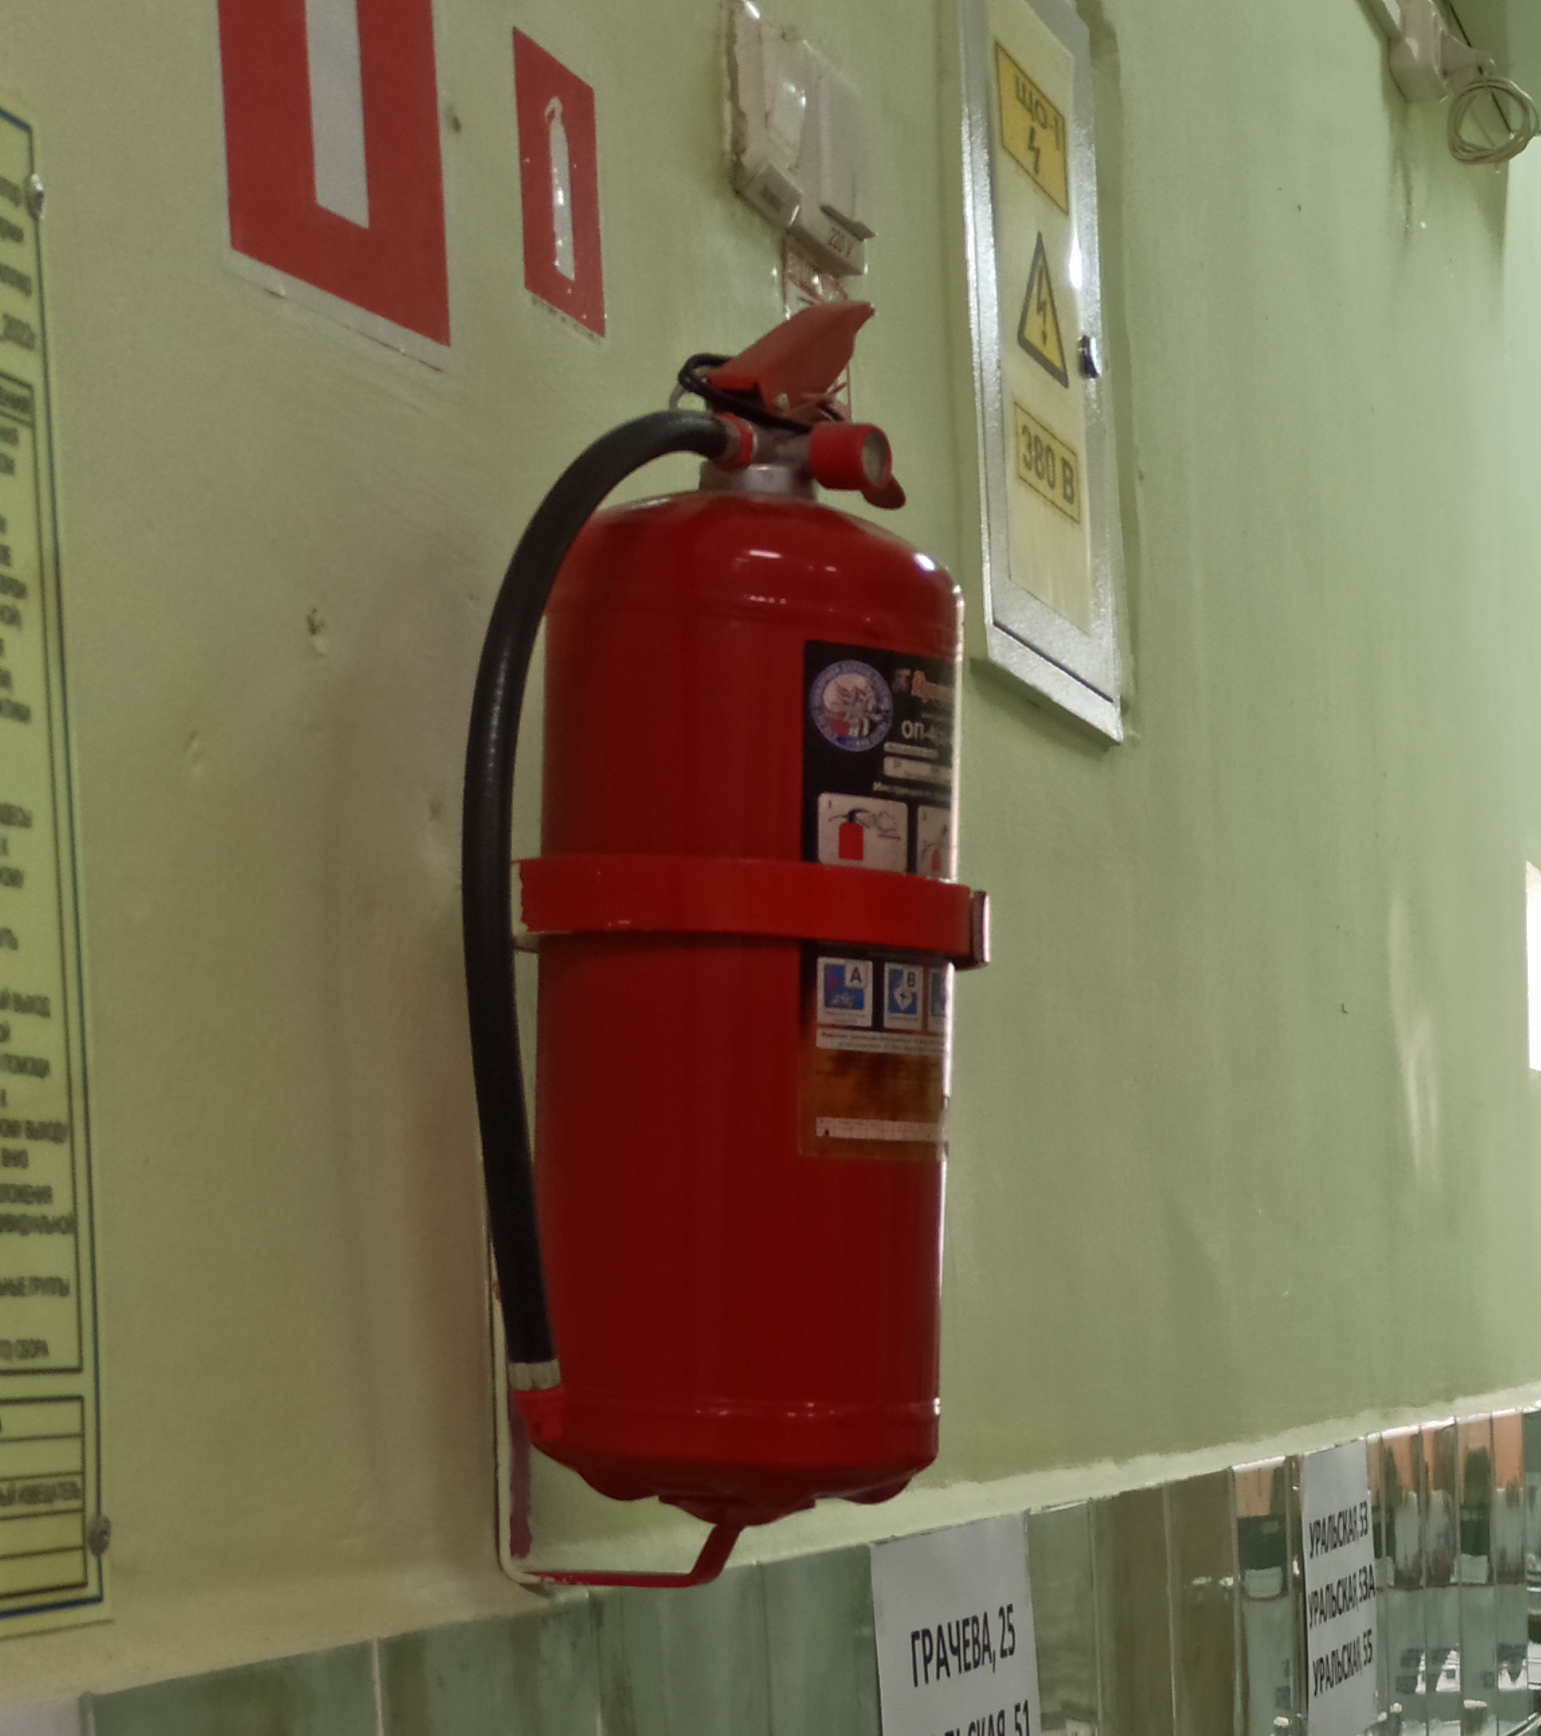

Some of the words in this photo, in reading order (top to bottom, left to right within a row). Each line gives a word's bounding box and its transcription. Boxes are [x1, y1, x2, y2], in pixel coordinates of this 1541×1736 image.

[1022, 424, 1056, 490] 380
[1062, 456, 1075, 505] В
[911, 1611, 996, 1688] ГРАЧЕВА,
[999, 1603, 1015, 1658] 25
